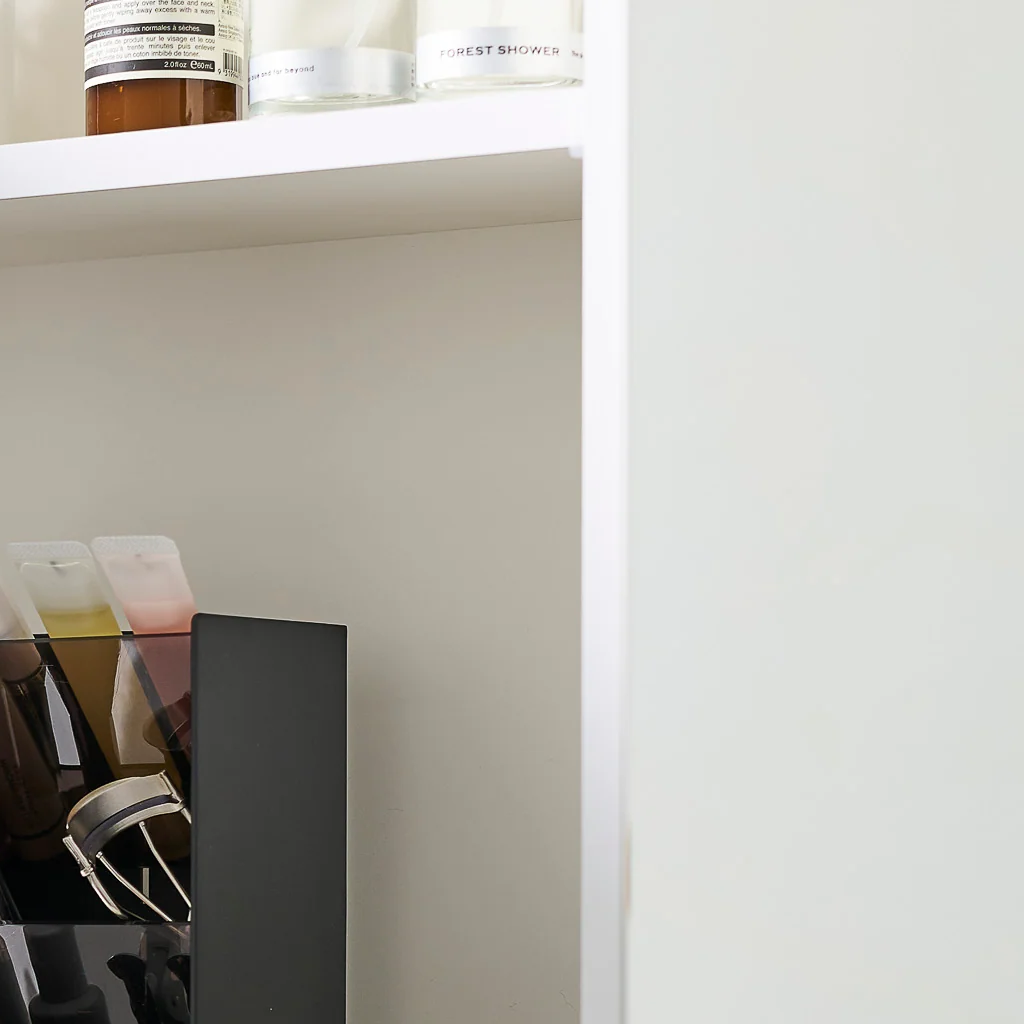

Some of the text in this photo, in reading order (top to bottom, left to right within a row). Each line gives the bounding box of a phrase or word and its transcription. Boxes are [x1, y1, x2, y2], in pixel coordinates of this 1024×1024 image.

[440, 45, 560, 57] FOREST SHOWER
[284, 65, 315, 74] beyond
